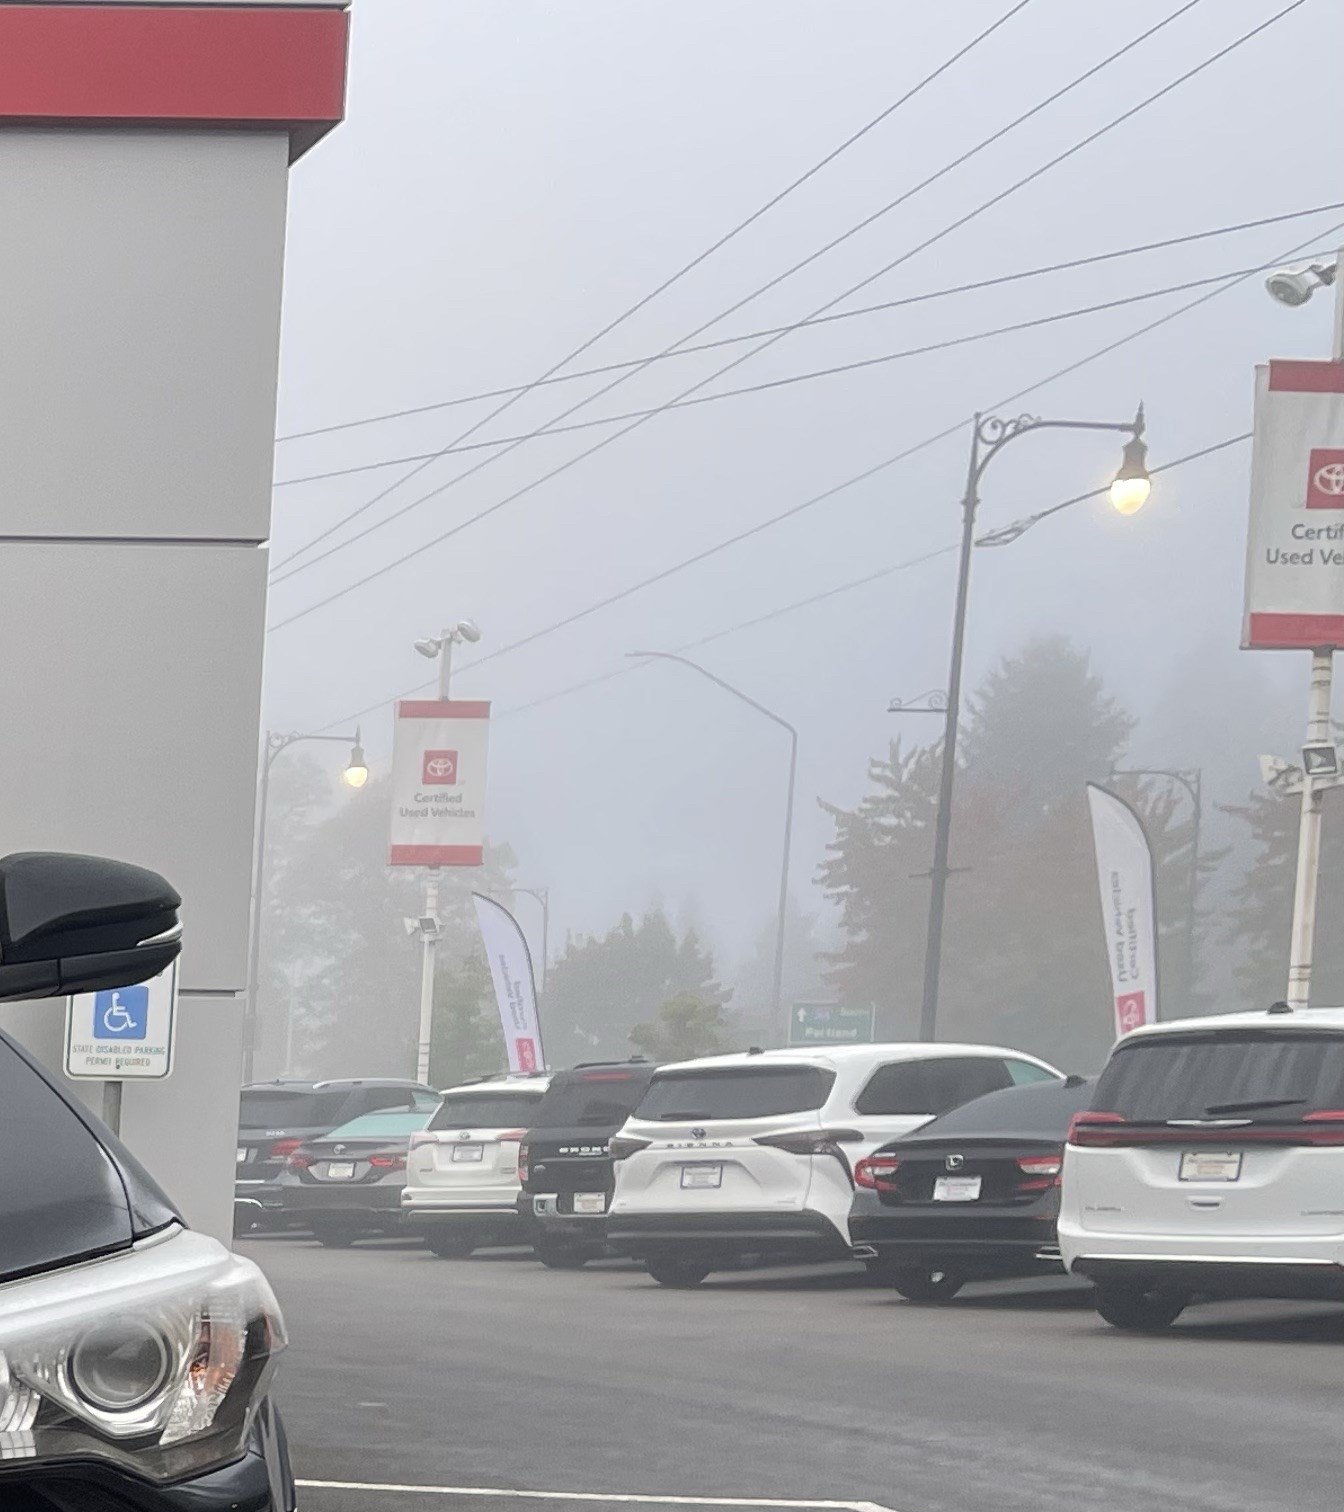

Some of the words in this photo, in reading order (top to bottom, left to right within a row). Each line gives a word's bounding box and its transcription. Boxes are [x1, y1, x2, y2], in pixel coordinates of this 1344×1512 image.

[1266, 548, 1313, 565] Used
[413, 792, 463, 804] Certified
[400, 807, 429, 818] Used
[430, 807, 476, 818] Vehicles
[72, 1044, 93, 1054] STATE
[96, 1045, 132, 1055] DISABLED
[134, 1046, 167, 1056] PARKING
[85, 1056, 112, 1067] PERMIT
[115, 1057, 152, 1067] REQUIRED
